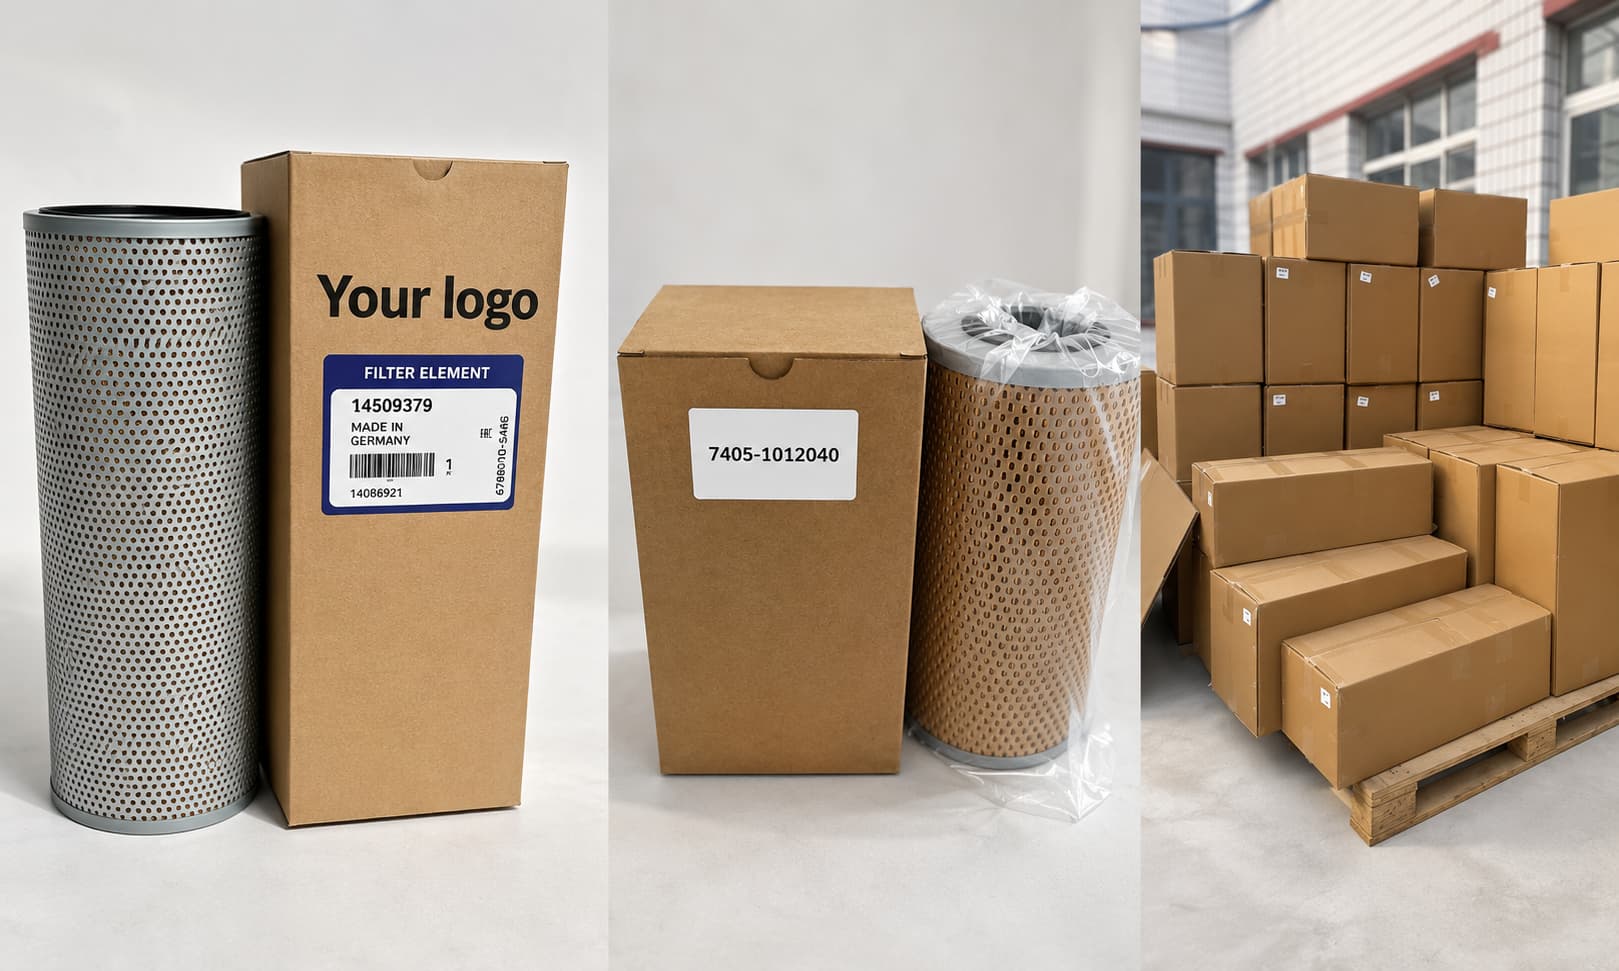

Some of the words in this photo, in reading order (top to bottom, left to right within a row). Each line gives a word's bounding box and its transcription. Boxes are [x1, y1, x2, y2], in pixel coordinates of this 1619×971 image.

[317, 274, 431, 318] Your
[444, 275, 539, 331] logo
[364, 366, 415, 379] FILTER
[420, 366, 490, 379] ELEMENT
[351, 398, 433, 413] 14509379
[351, 422, 387, 432] MADE
[392, 422, 403, 432] IN
[351, 436, 410, 446] GERMANY
[708, 446, 840, 463] 7405-1012040
[446, 458, 452, 471] 1
[350, 488, 403, 499] 14086921
